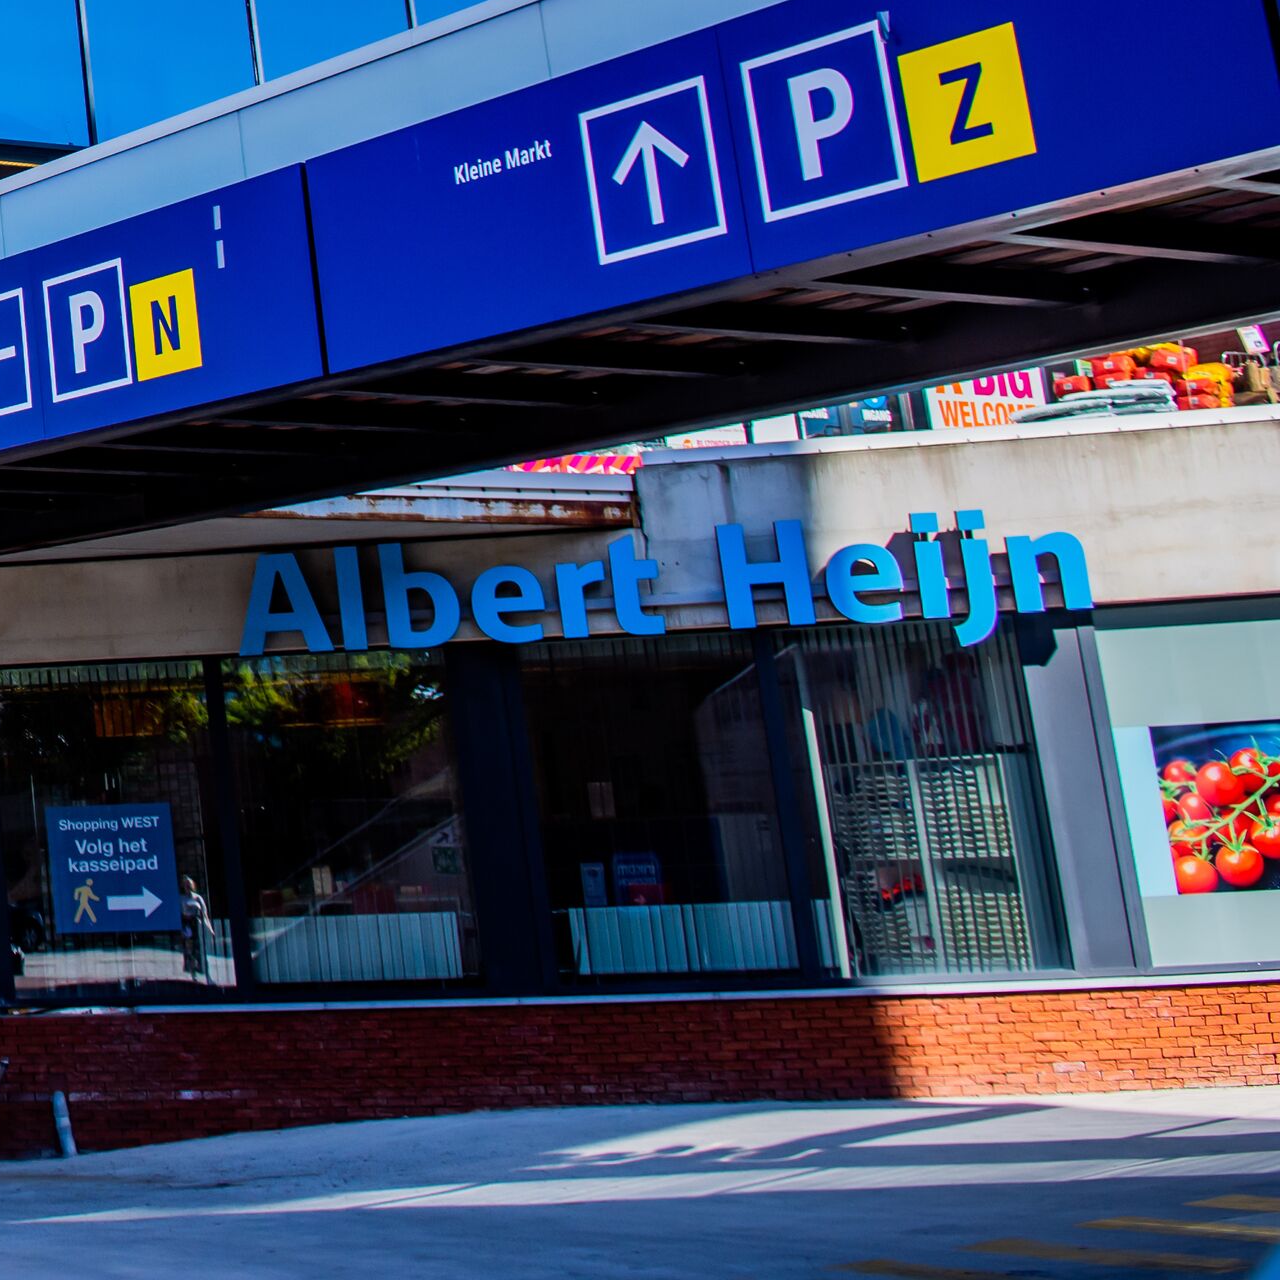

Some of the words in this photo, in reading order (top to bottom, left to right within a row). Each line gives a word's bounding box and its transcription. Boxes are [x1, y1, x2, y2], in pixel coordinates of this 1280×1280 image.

[787, 67, 854, 182] P
[939, 61, 995, 146] Z
[454, 158, 502, 185] Kleine
[505, 139, 552, 170] Markt
[68, 290, 105, 374] P
[150, 294, 181, 356] N
[938, 400, 1036, 428] WELCO
[240, 533, 666, 657] Albert
[716, 509, 1094, 647] Heijn
[59, 818, 119, 832] Shopping
[121, 816, 159, 828] WEST
[74, 839, 113, 857] Volg
[119, 837, 148, 853] het
[68, 855, 159, 874] kasseipad
